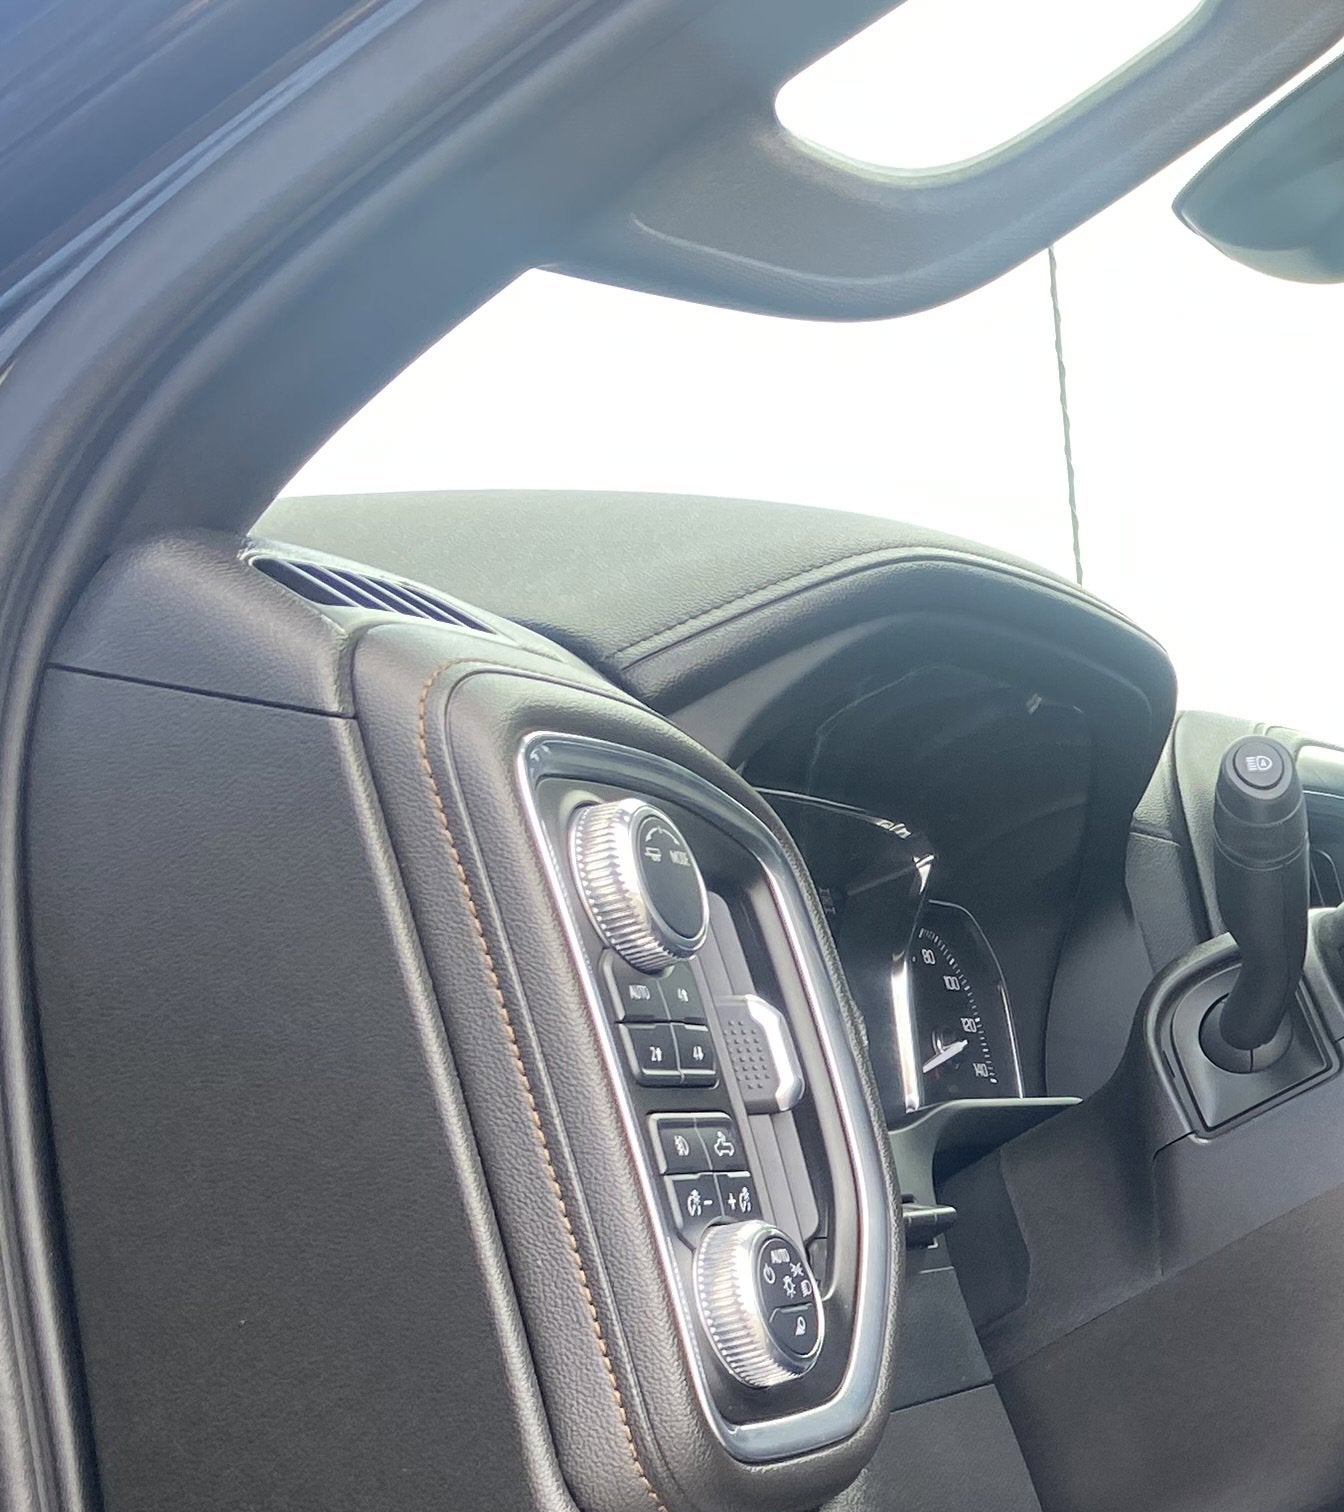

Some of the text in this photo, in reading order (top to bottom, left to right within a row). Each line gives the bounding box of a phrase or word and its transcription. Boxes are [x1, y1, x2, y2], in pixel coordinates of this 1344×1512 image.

[922, 948, 935, 965] 80
[943, 975, 960, 992] 100
[960, 1018, 978, 1033] 120
[973, 1062, 989, 1077] 140
